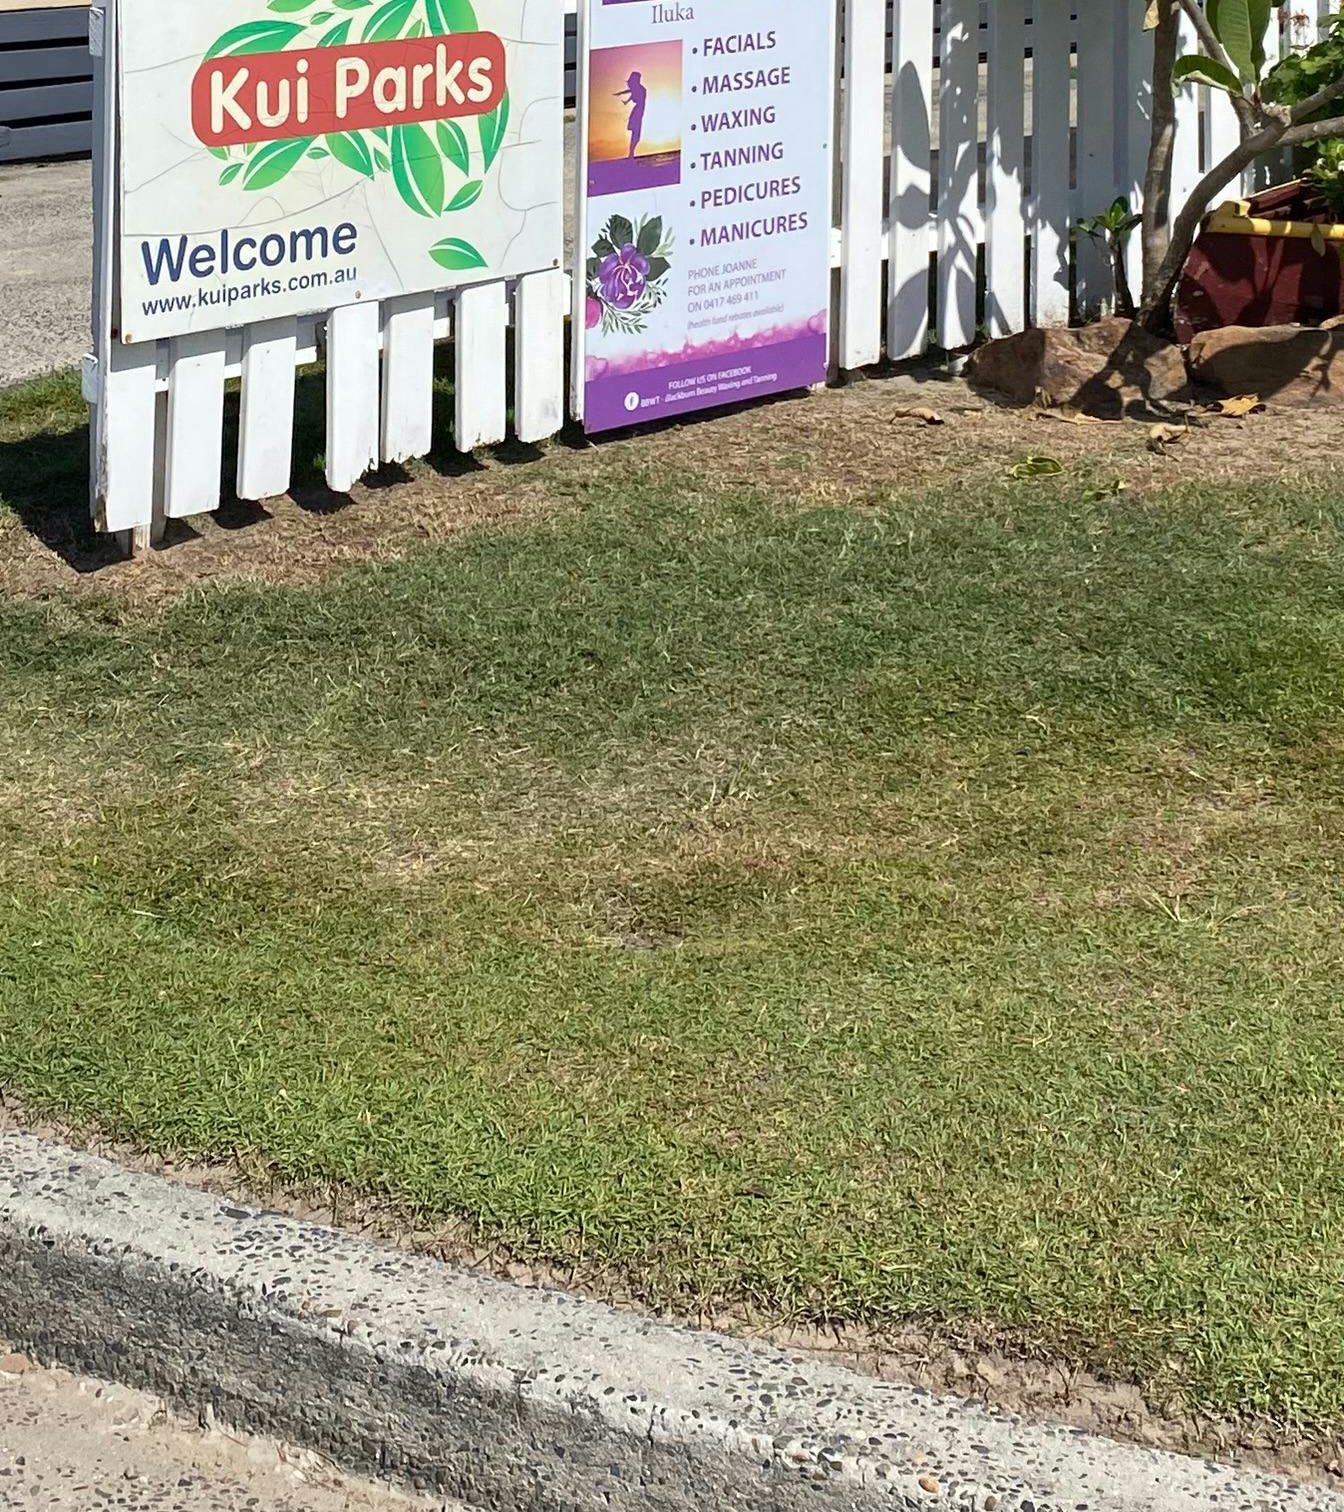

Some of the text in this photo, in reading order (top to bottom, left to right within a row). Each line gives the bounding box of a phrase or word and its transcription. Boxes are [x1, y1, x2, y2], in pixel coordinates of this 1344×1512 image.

[651, 1, 695, 25] Iluka
[703, 30, 777, 57] FACIALS
[210, 43, 494, 134] Kui Parks
[702, 66, 791, 95] MASSAGE
[700, 106, 776, 133] WAXING
[700, 142, 784, 171] TANNING
[700, 176, 801, 209] PEDICURES
[700, 212, 808, 247] MANICURES
[141, 221, 358, 287] Welcome
[688, 264, 720, 281] PHONE
[688, 268, 787, 297] FOR AN APPOINTMENT
[141, 265, 358, 317] www.kuiparks.com.au
[688, 300, 702, 313] ON
